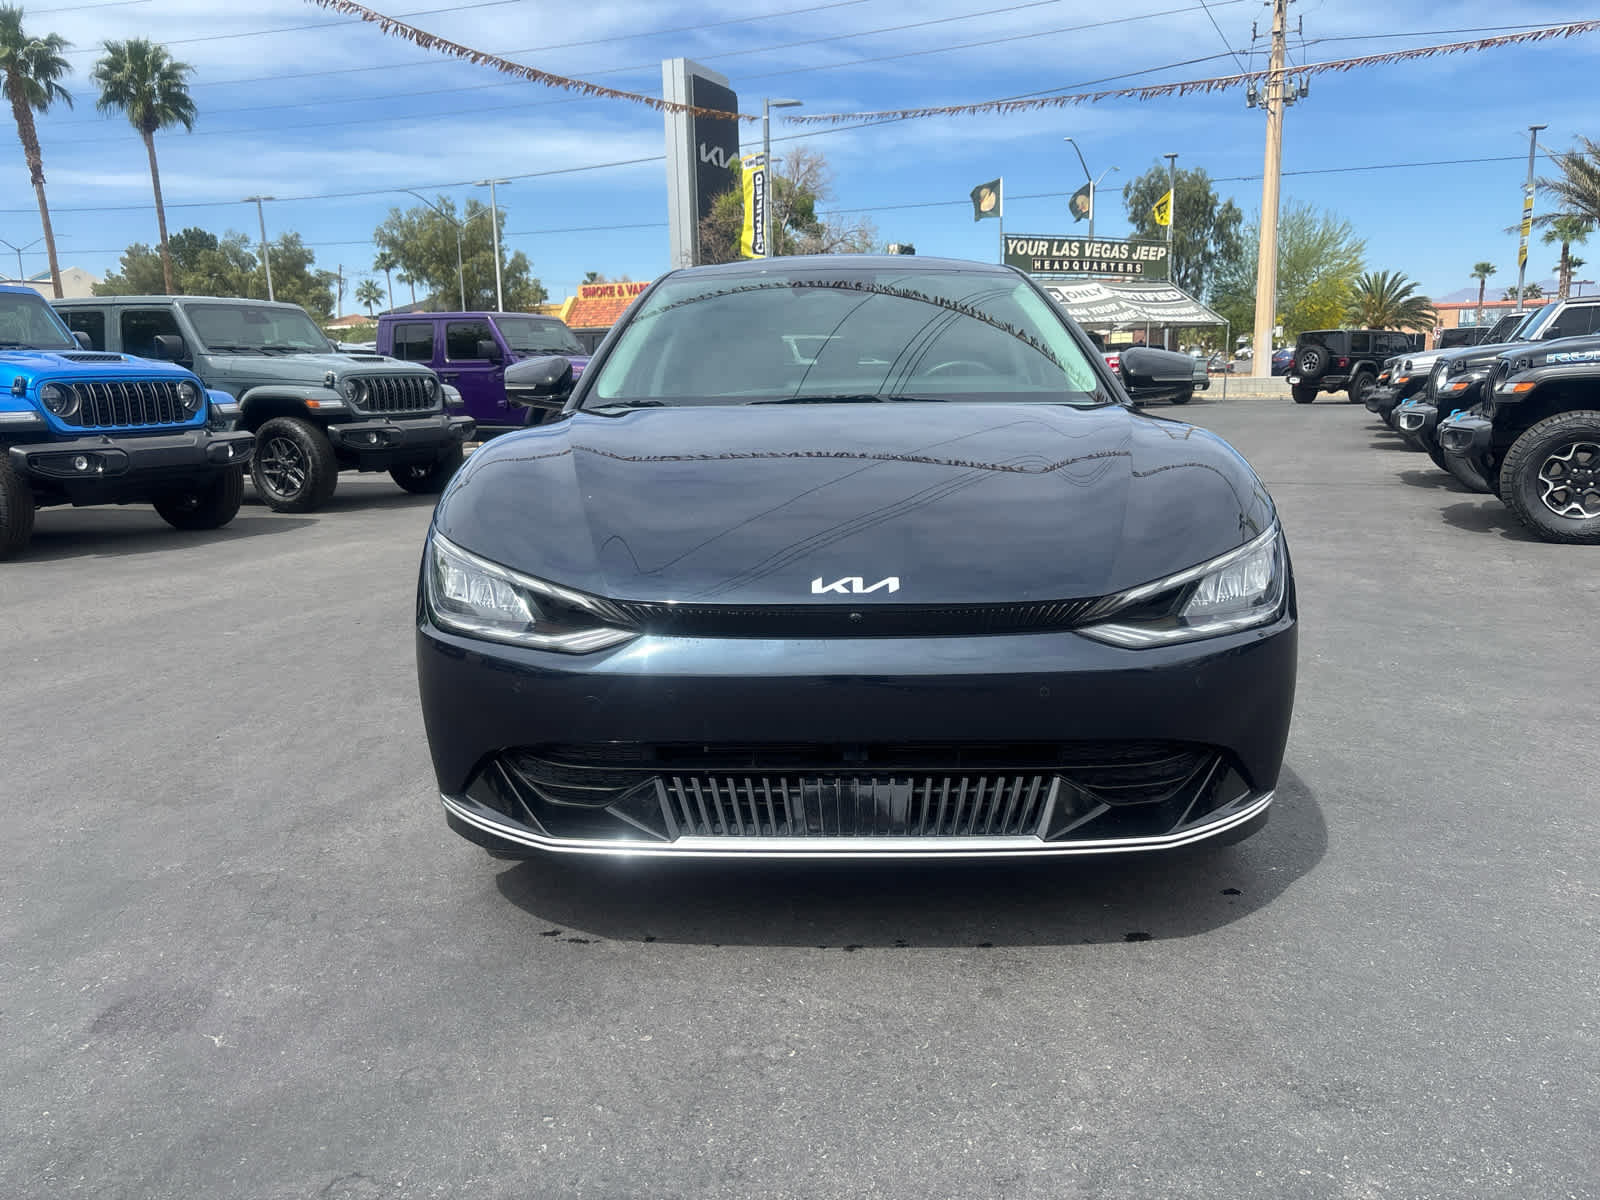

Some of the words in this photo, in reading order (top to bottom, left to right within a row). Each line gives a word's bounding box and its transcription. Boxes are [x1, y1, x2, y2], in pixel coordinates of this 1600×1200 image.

[754, 172, 764, 253] CERTIFIED
[1007, 239, 1048, 255] YOUR
[1052, 240, 1079, 257] LAS
[1084, 242, 1129, 259] VEGAS
[1132, 246, 1167, 261] JEEP
[1034, 259, 1142, 273] HEADQUARTERS
[582, 285, 615, 299] SMOKE
[617, 284, 624, 297] &
[1066, 287, 1103, 299] ONLY
[811, 576, 900, 594] KIA
